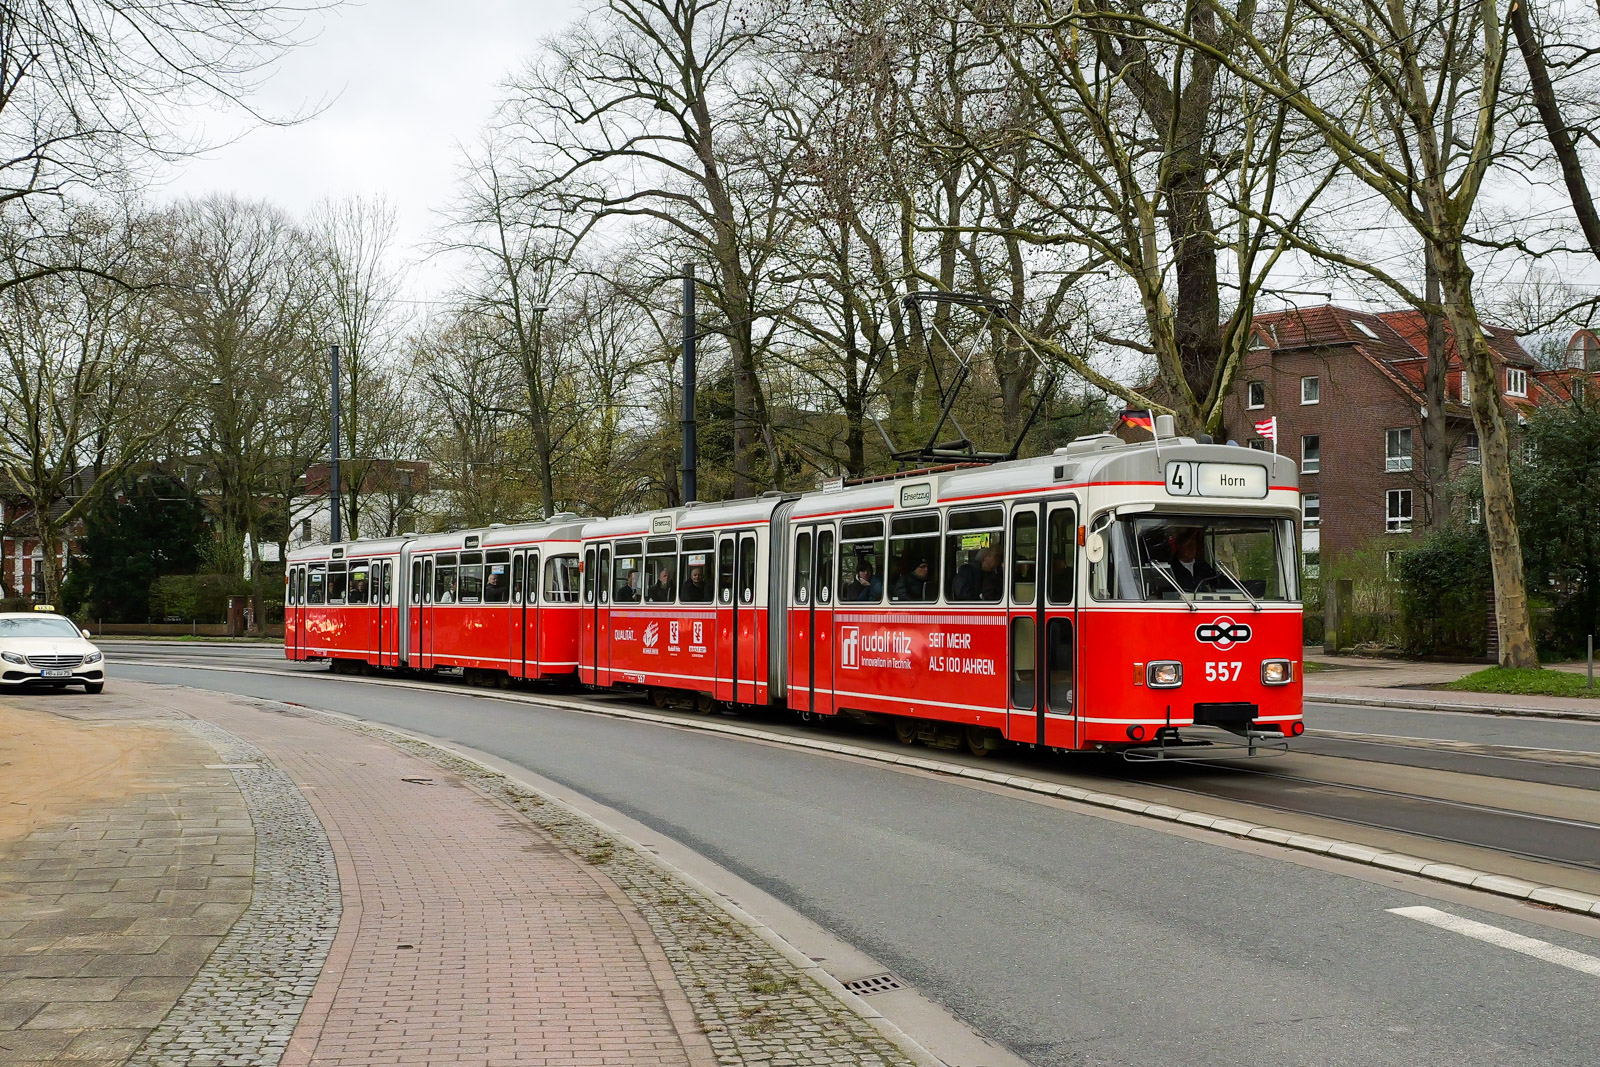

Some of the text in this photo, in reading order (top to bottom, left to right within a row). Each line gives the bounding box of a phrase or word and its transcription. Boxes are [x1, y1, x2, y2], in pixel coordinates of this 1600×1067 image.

[1172, 464, 1184, 489] 4
[1220, 474, 1246, 487] Horn
[861, 630, 912, 654] rudolf fritz
[929, 632, 971, 649] SEIT MEHR
[861, 656, 912, 670] Innovation in Technik
[928, 655, 996, 676] ALS 100 JAHREN.
[1205, 661, 1243, 682] 557
